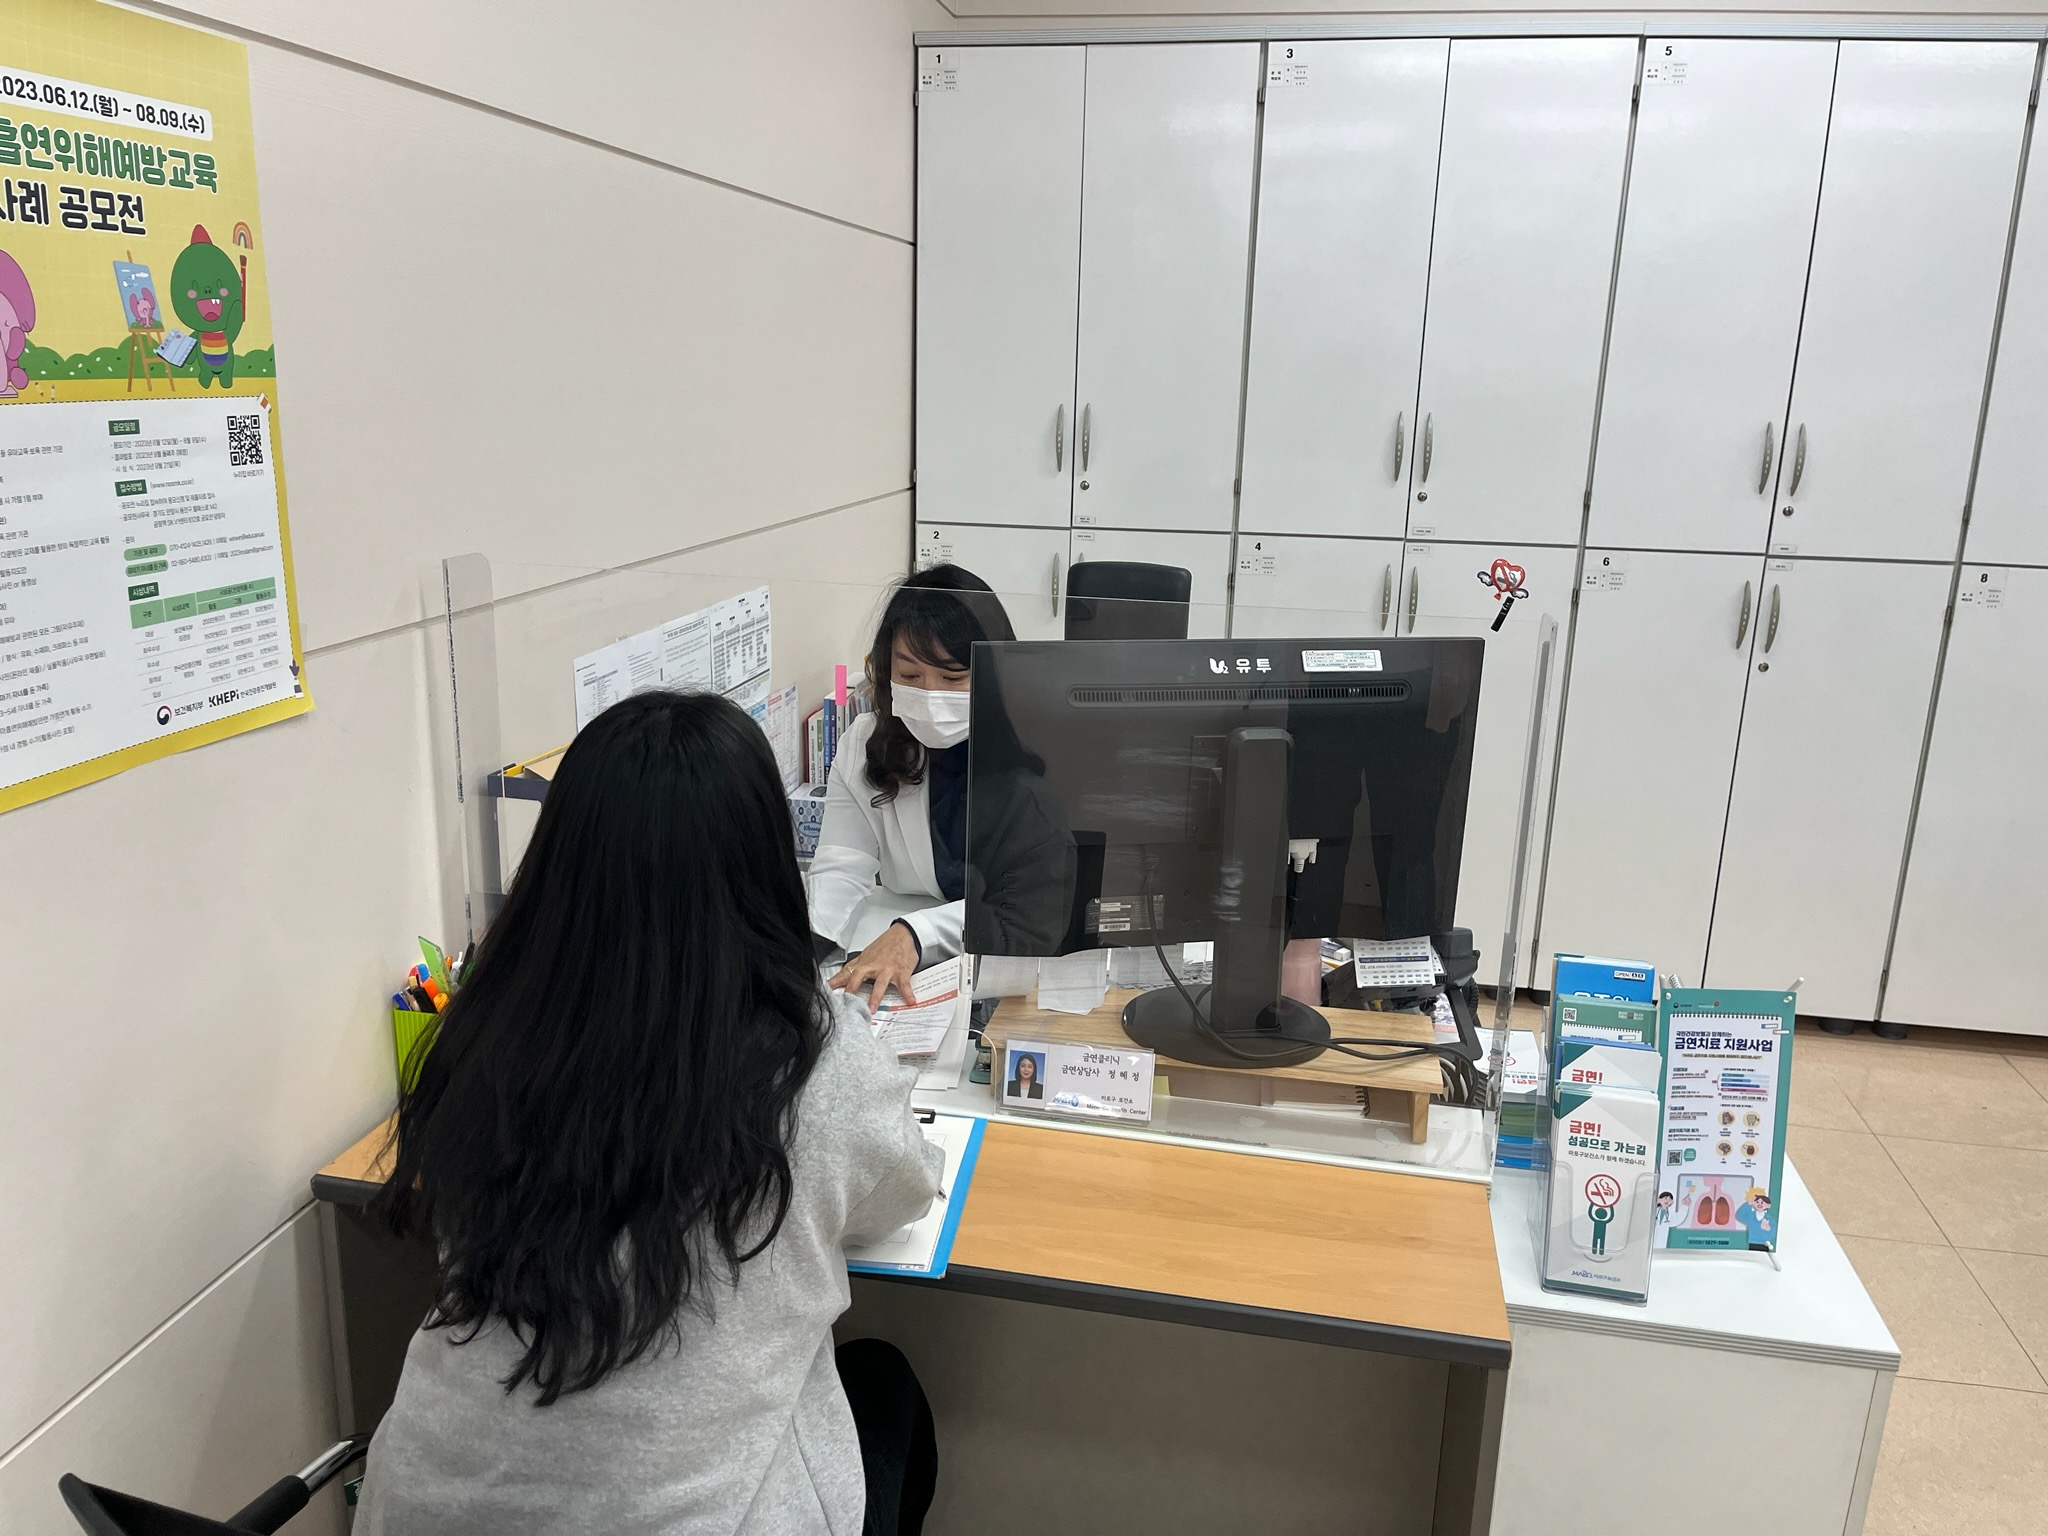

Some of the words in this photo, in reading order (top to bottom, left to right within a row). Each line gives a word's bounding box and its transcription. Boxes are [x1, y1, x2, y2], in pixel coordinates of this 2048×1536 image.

[1286, 48, 1294, 58] 3
[1665, 46, 1672, 56] 5
[936, 54, 941, 64] 1
[0, 75, 118, 118] 023.06.12.(월)
[136, 104, 205, 134] 08.09.(수)
[59, 186, 146, 236] 공모전
[933, 531, 940, 540] 2
[1255, 542, 1261, 551] 4
[1603, 557, 1610, 566] 6
[1980, 573, 1988, 583] 8
[174, 701, 203, 716] 보건복지부
[1674, 1037, 1721, 1050] 금연치료
[1723, 1038, 1773, 1052] 지원사업
[1082, 1053, 1120, 1065] 금연클리닉
[1061, 1065, 1100, 1077] 금연상담사
[1572, 1069, 1603, 1084] 금연!
[1570, 1120, 1602, 1137] 금연!
[1568, 1136, 1610, 1151] 성공으로
[1614, 1141, 1646, 1156] 가는길
[1568, 1150, 1605, 1161] 마포구보건소가
[1618, 1157, 1646, 1166] 하겠습니다.
